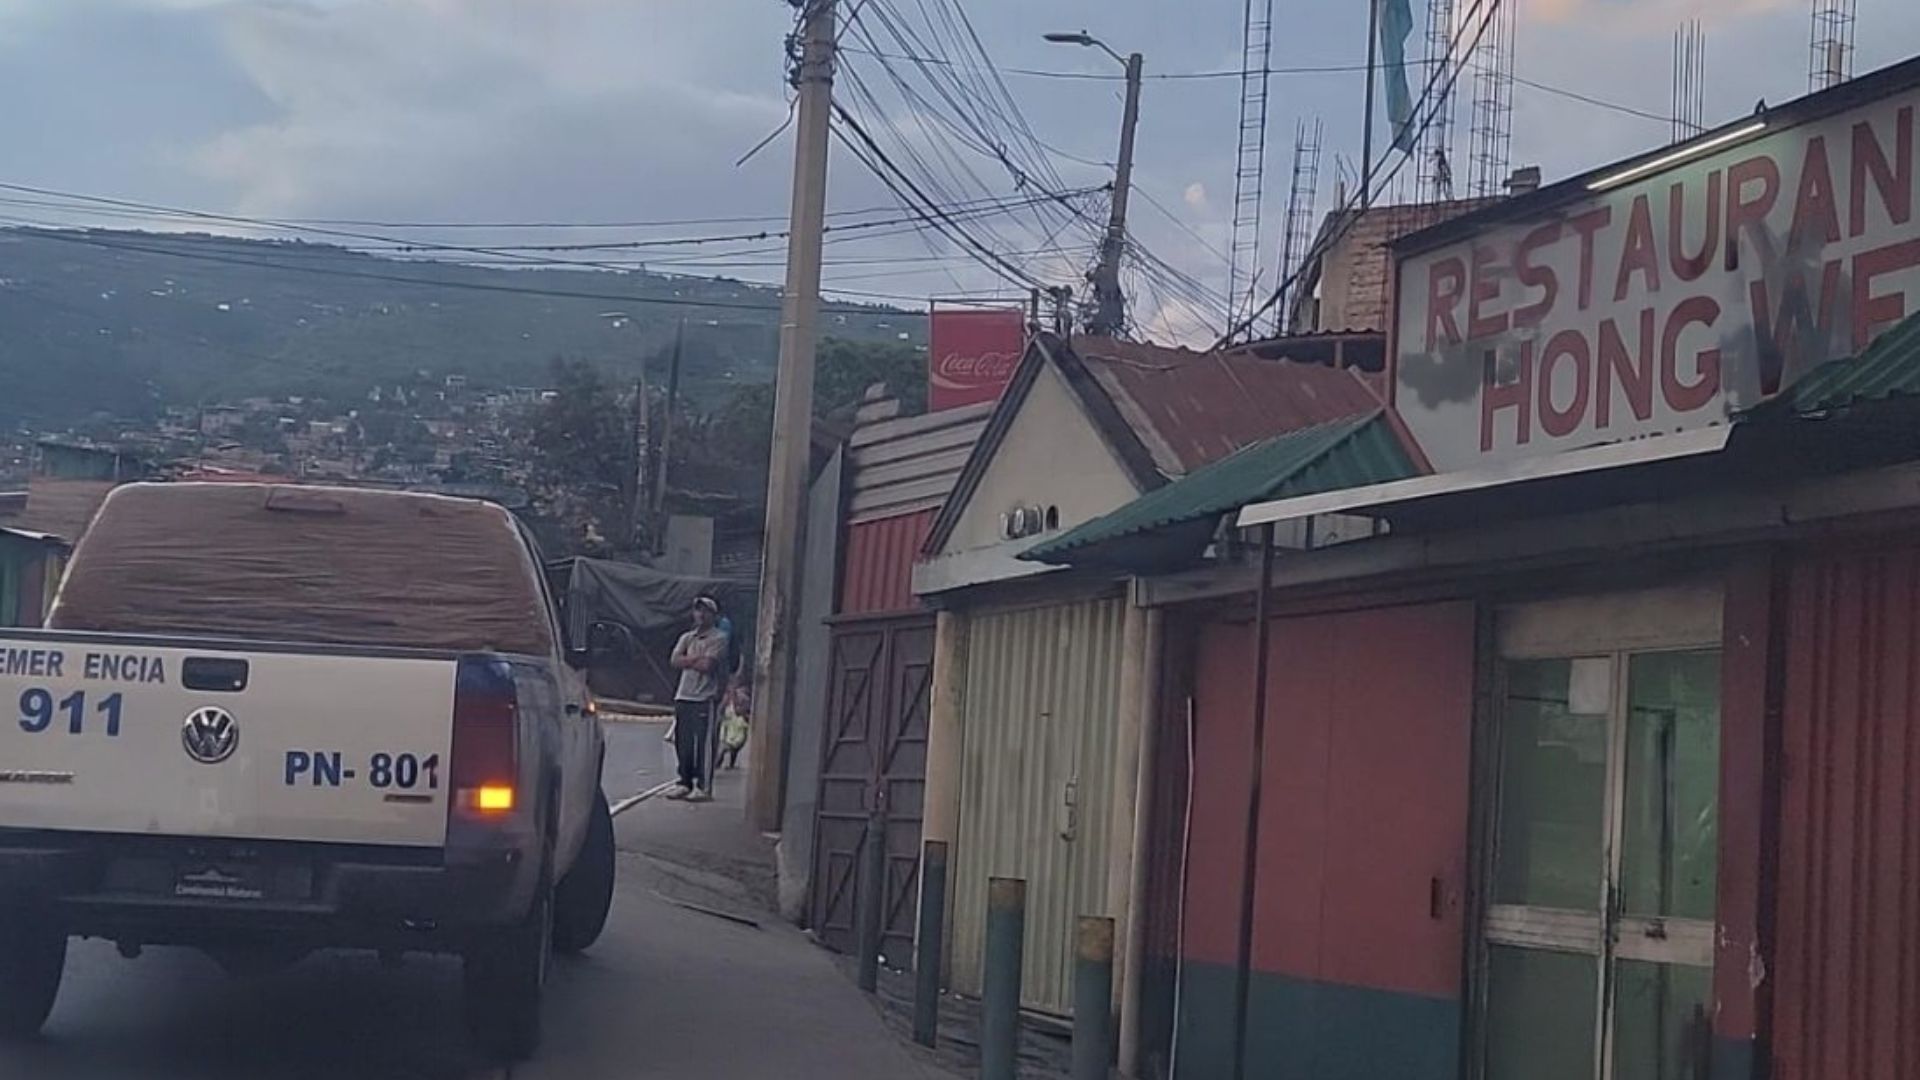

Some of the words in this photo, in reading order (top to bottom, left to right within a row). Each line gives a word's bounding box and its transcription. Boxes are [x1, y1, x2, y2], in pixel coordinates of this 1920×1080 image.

[1480, 296, 1721, 453] HONG
[83, 652, 165, 684] ENCIA
[19, 687, 122, 737] 911
[285, 751, 355, 786] PN-
[369, 752, 439, 789] 801
